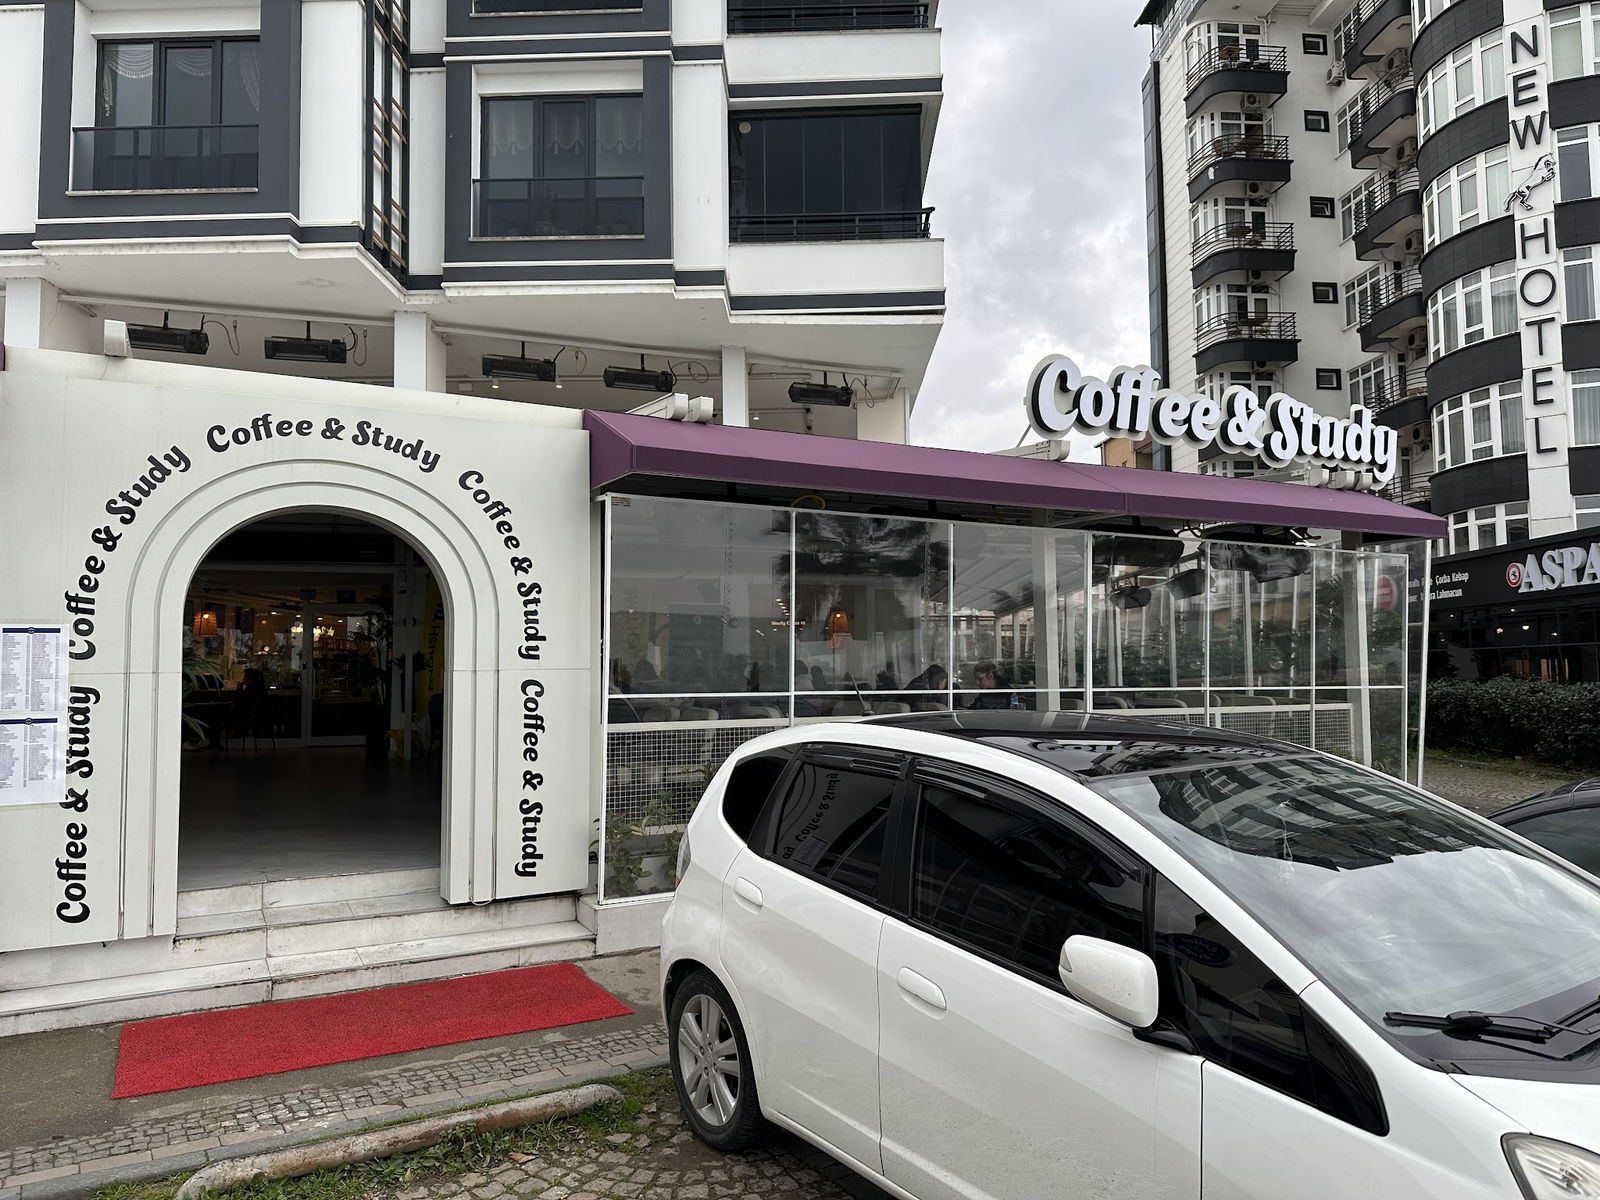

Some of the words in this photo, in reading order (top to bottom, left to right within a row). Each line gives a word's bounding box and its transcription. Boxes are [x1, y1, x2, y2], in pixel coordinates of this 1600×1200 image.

[1510, 24, 1546, 150] NEW
[1519, 217, 1557, 454] HOTEL
[206, 413, 314, 454] Coffee
[320, 417, 346, 442] &
[351, 419, 442, 474] Study
[1030, 355, 1221, 443] Coffee
[1224, 387, 1265, 449] &
[1264, 396, 1398, 482] Study
[105, 445, 192, 526] Study
[458, 470, 521, 550] Coffee
[91, 525, 123, 553] &
[510, 556, 533, 577] &
[65, 555, 106, 661] Coffee
[516, 581, 547, 661] Study
[520, 679, 546, 763] Coffee
[58, 787, 89, 813] &
[522, 769, 544, 792] &
[54, 822, 91, 924] Coffee
[514, 798, 544, 879] Study
